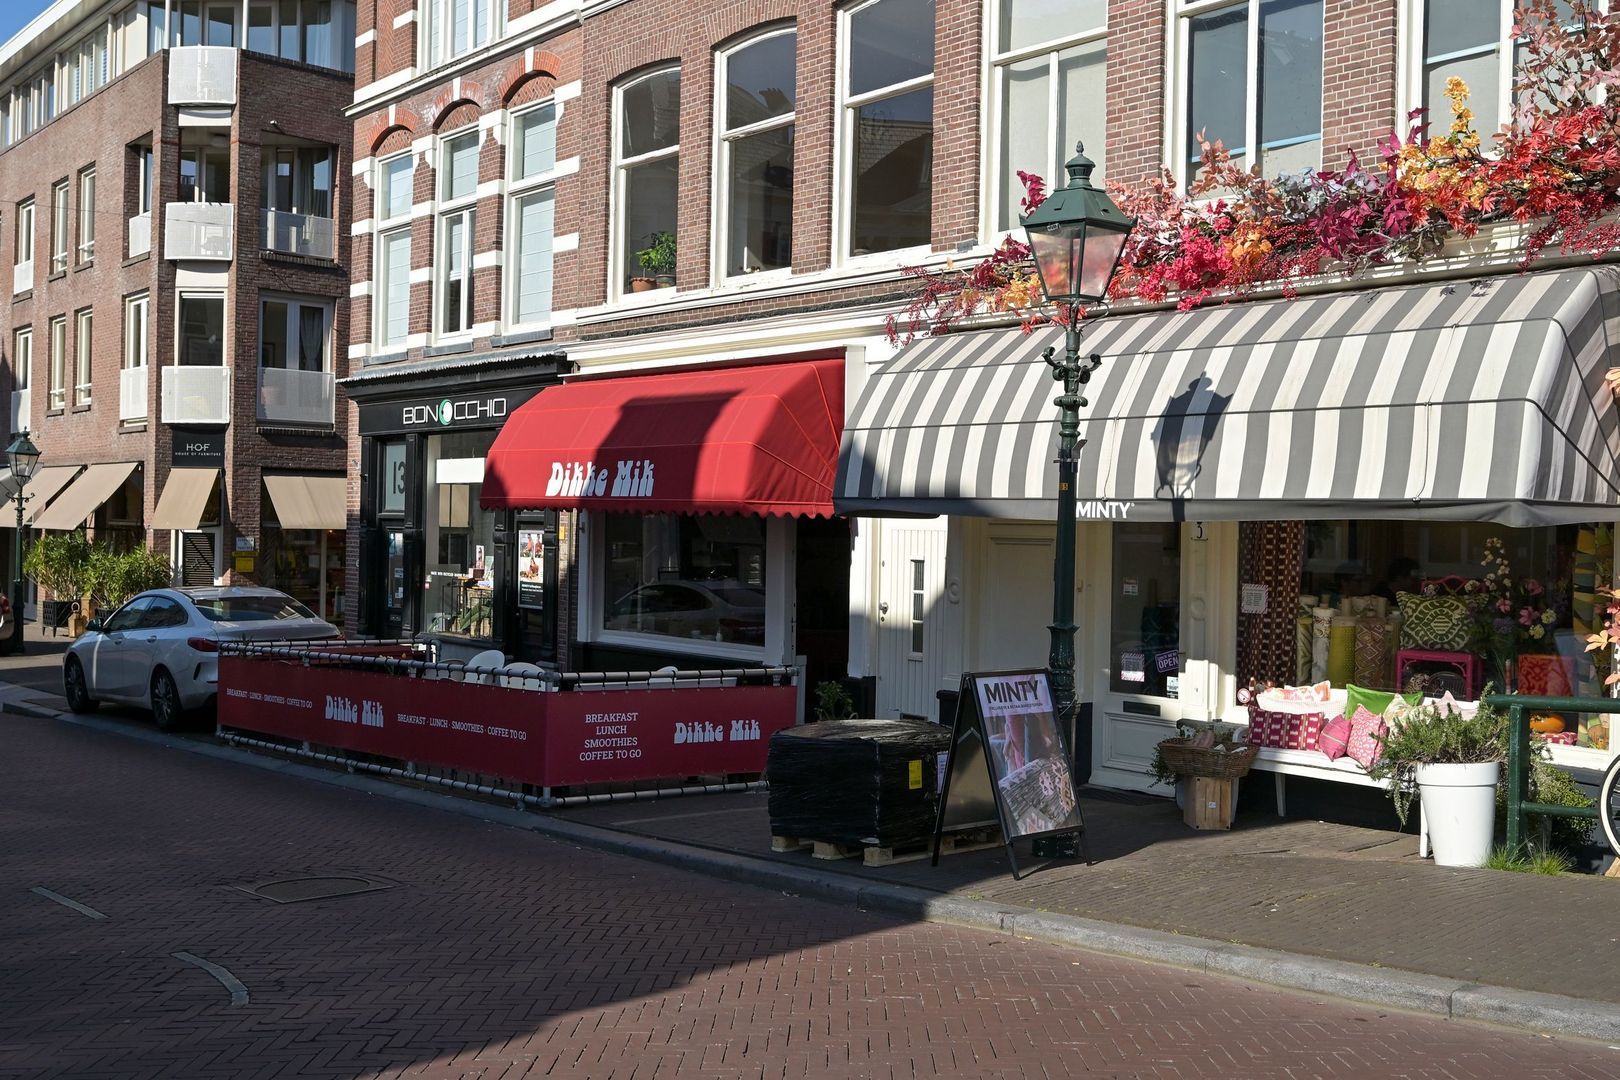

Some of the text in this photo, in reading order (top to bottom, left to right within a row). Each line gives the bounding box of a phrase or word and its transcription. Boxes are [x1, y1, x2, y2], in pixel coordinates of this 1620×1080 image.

[392, 460, 406, 494] 13
[545, 460, 655, 497] Dikke Mik
[1076, 501, 1131, 518] MINTY
[1158, 656, 1179, 669] OPEN
[983, 680, 1039, 704] MINTY
[325, 695, 384, 728] Dikke Mik
[585, 712, 639, 723] BREAKFAST
[397, 713, 527, 741] BREAKFAST LUNCH SMOOTHIES COFFEE TO GO
[596, 725, 627, 735] LUNCH
[674, 719, 761, 744] Dikke Mik
[584, 737, 638, 749] SMOOTHIES
[579, 749, 642, 762] COFFEE TO GO
